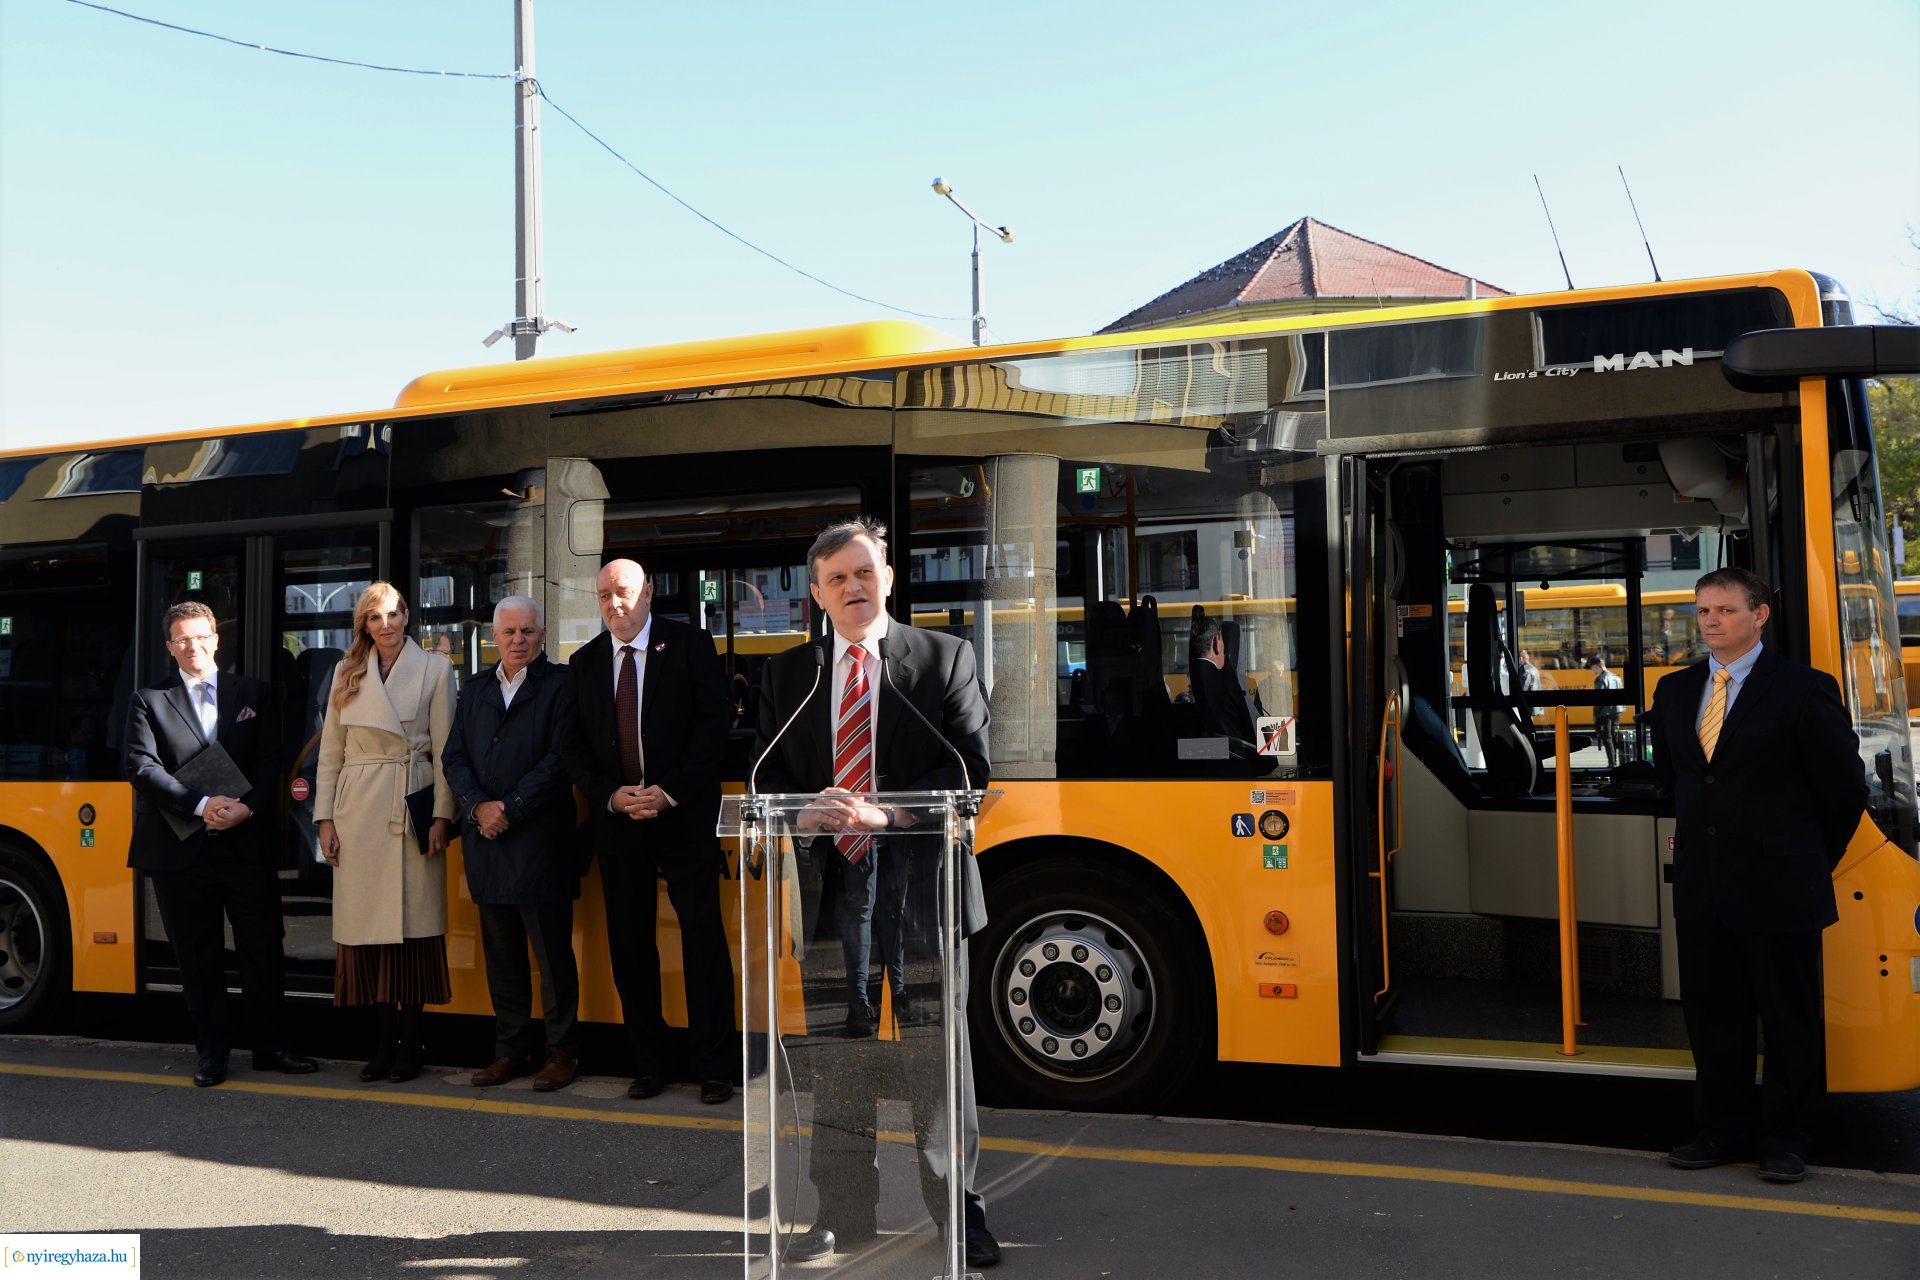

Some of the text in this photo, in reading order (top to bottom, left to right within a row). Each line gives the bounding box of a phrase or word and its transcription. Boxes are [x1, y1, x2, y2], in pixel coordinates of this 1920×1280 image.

[1593, 347, 1694, 373] MAN
[1493, 367, 1580, 381] Lion's City
